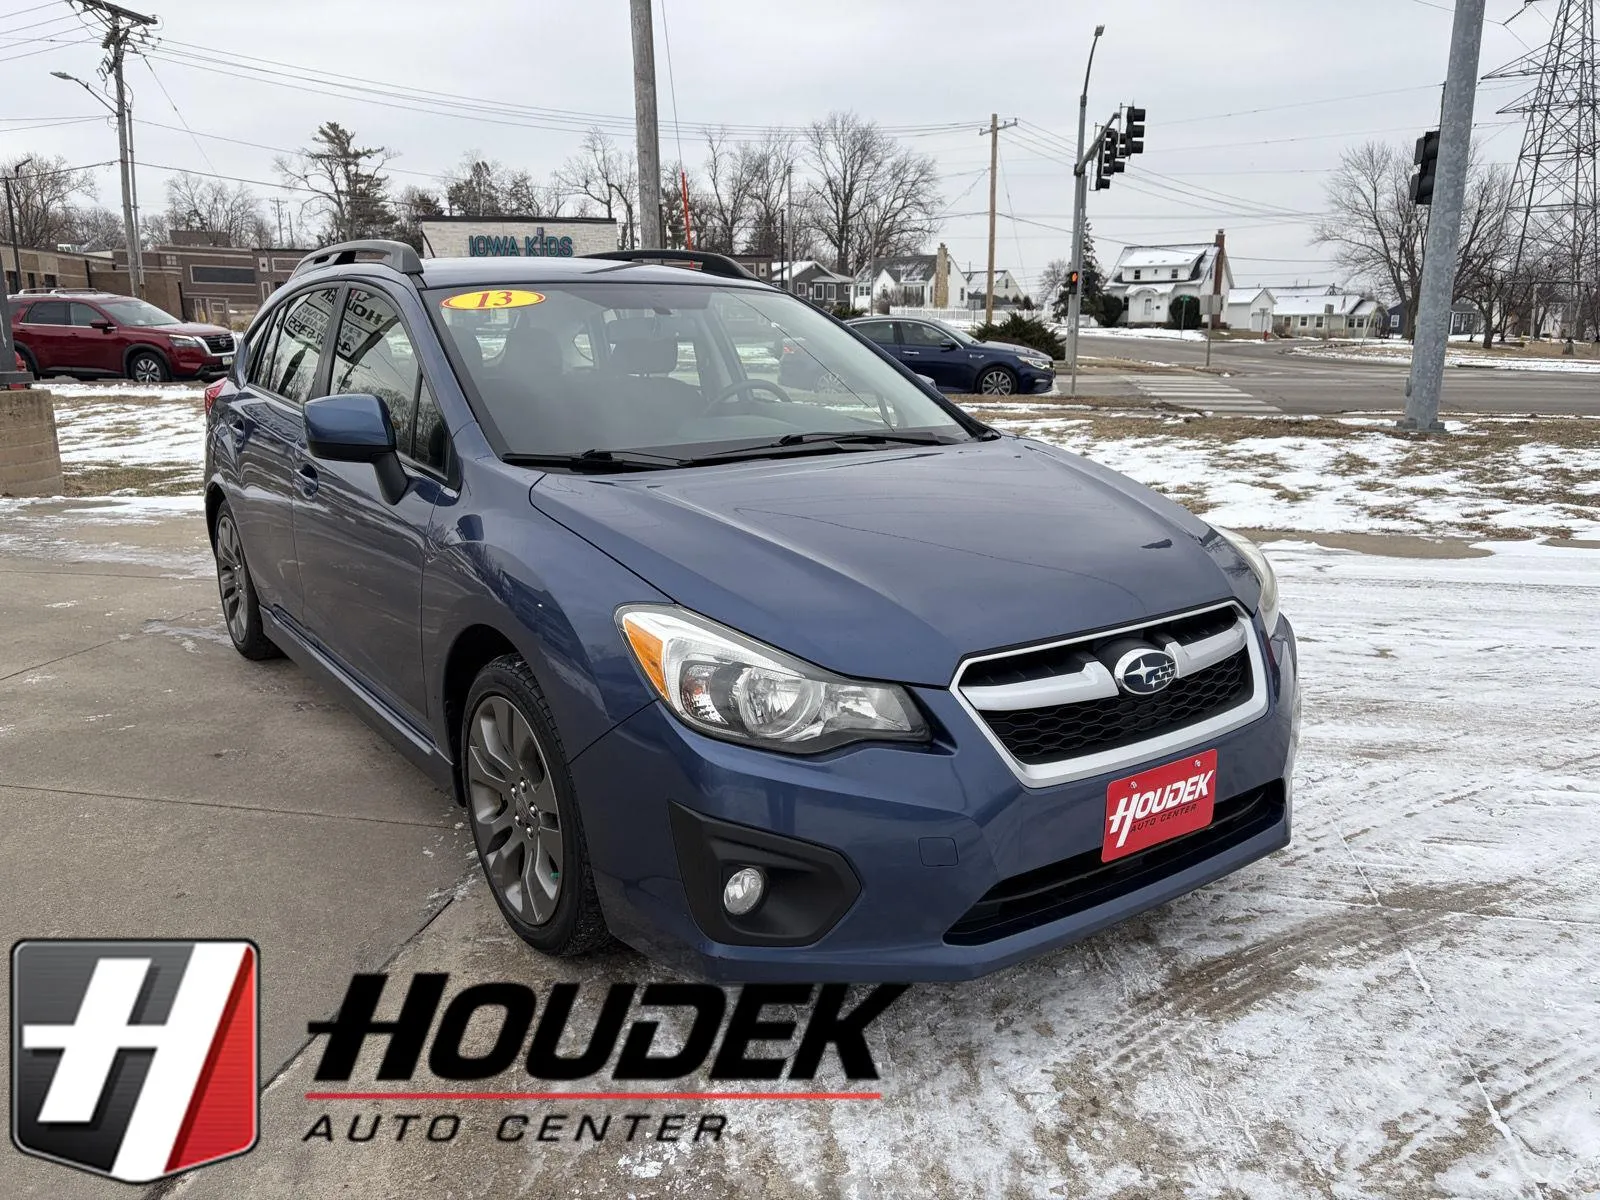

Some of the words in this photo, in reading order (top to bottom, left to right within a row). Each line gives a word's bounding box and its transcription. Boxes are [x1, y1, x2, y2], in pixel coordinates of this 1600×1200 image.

[468, 235, 521, 257] IOWA
[477, 291, 513, 308] 13
[1108, 769, 1215, 849] HOUDEK
[1130, 817, 1157, 833] AUTO
[1160, 803, 1198, 822] CENTER
